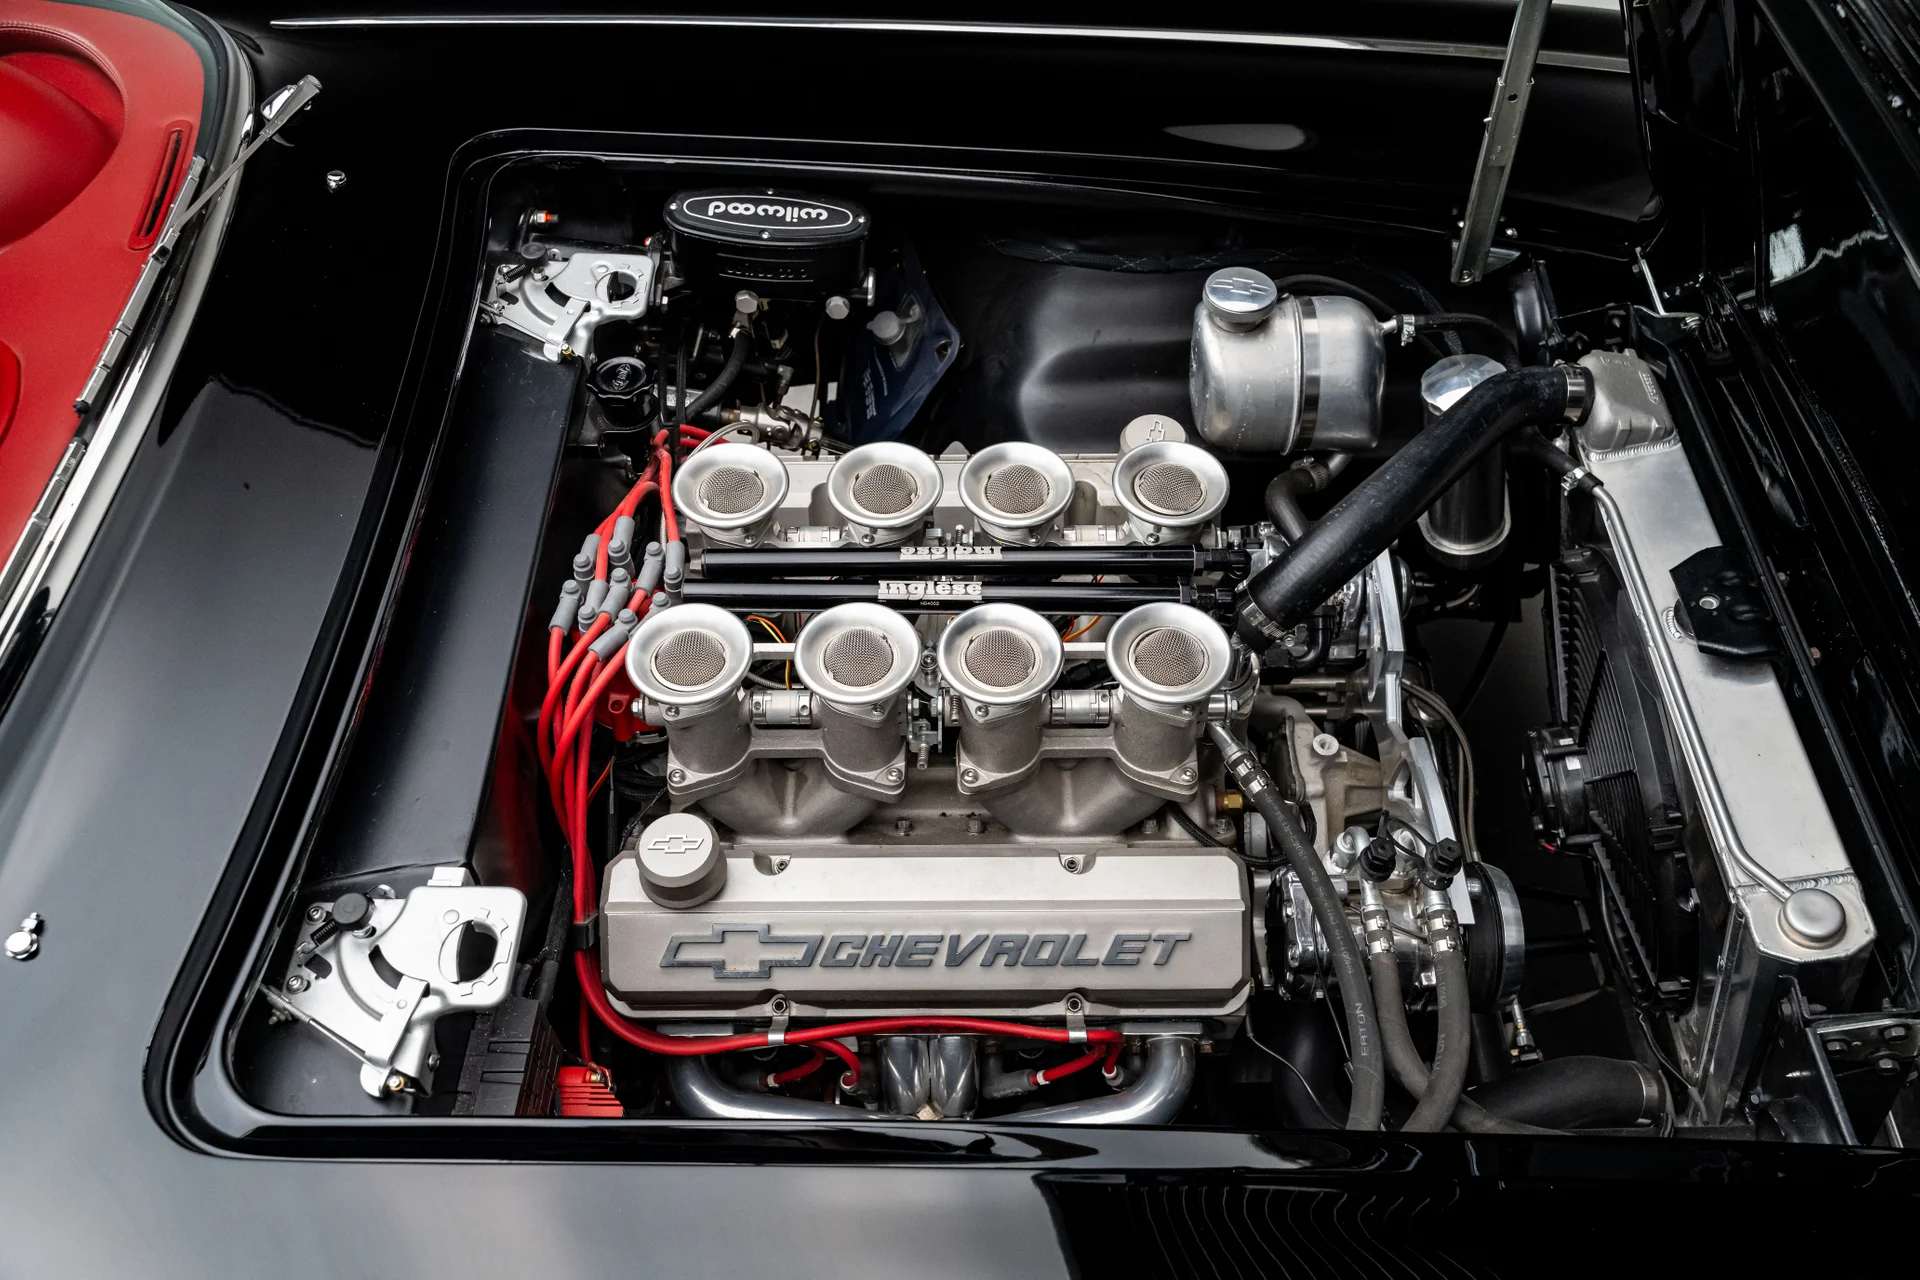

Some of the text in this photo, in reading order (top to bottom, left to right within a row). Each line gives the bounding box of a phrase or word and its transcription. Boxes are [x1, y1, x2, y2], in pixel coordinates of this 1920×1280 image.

[708, 200, 828, 222] wilwood
[878, 581, 982, 600] Inglese
[818, 933, 1192, 967] CHEVROLET
[1355, 1003, 1369, 1056] EATON
